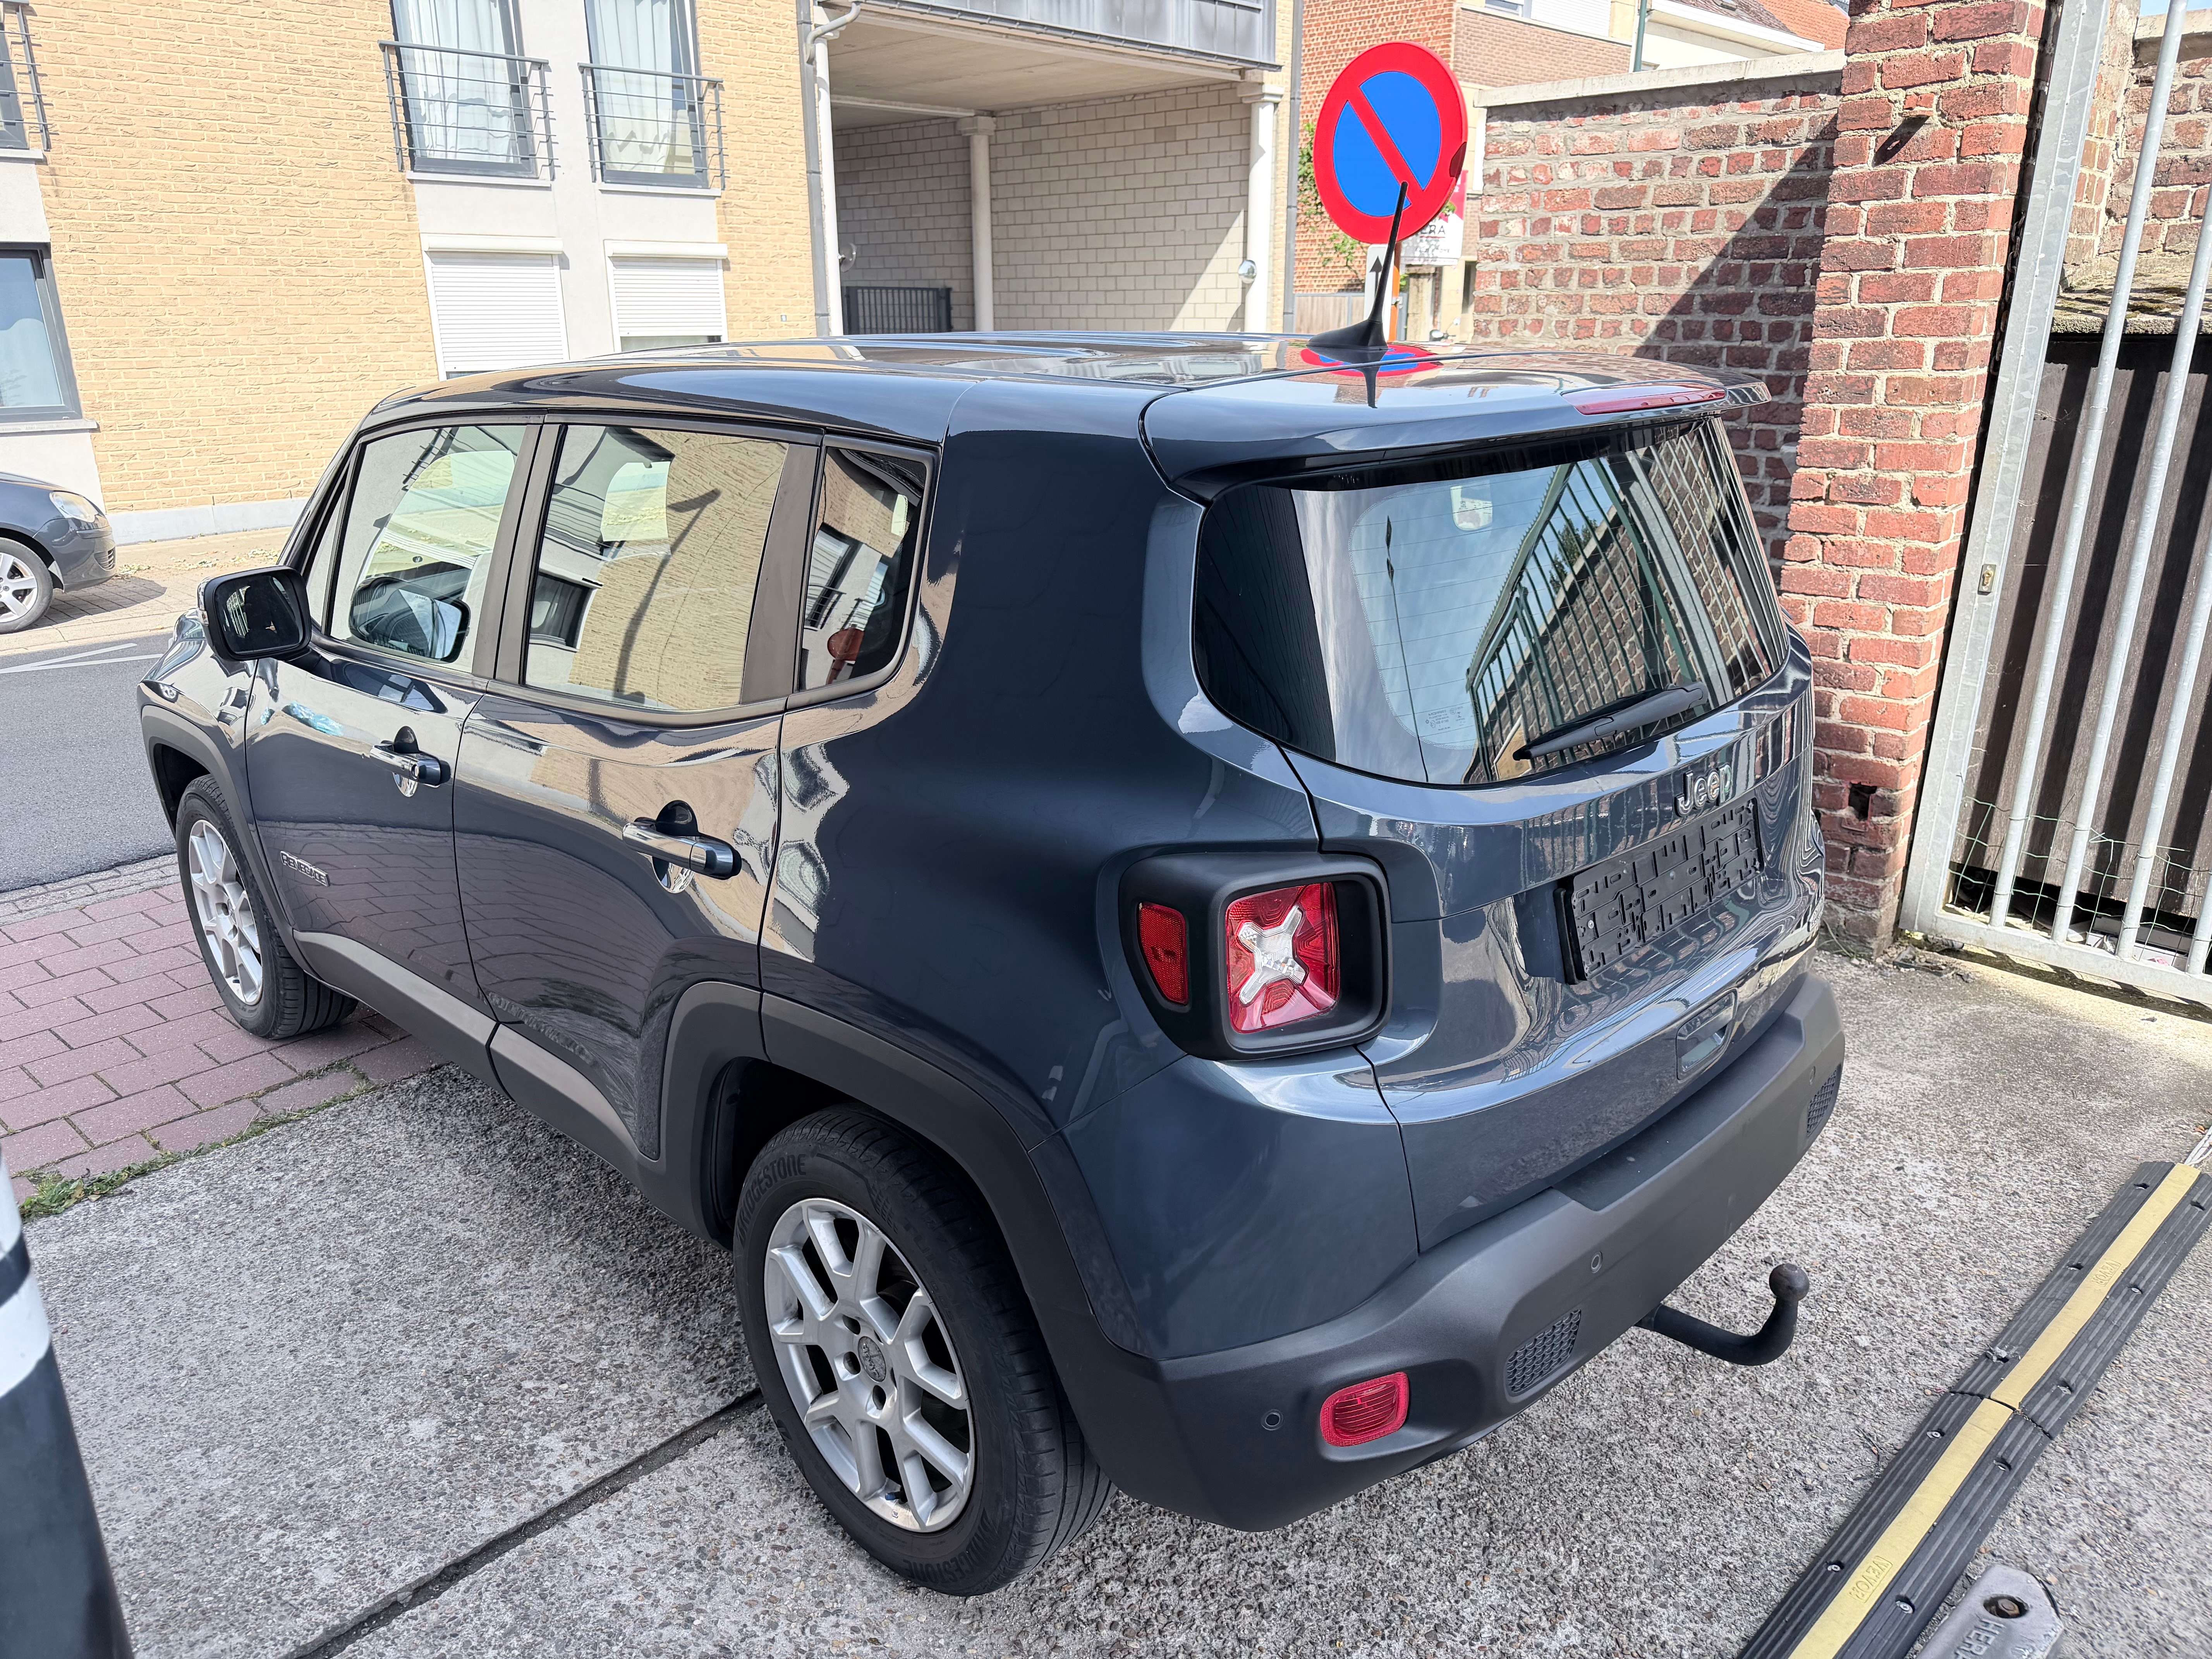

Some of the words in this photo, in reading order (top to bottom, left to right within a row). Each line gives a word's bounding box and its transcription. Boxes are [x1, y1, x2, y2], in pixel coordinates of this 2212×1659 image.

[1675, 763, 1732, 816] Jeep
[280, 851, 328, 887] RENEGADE
[1849, 1561, 1890, 1601] VEVOR
